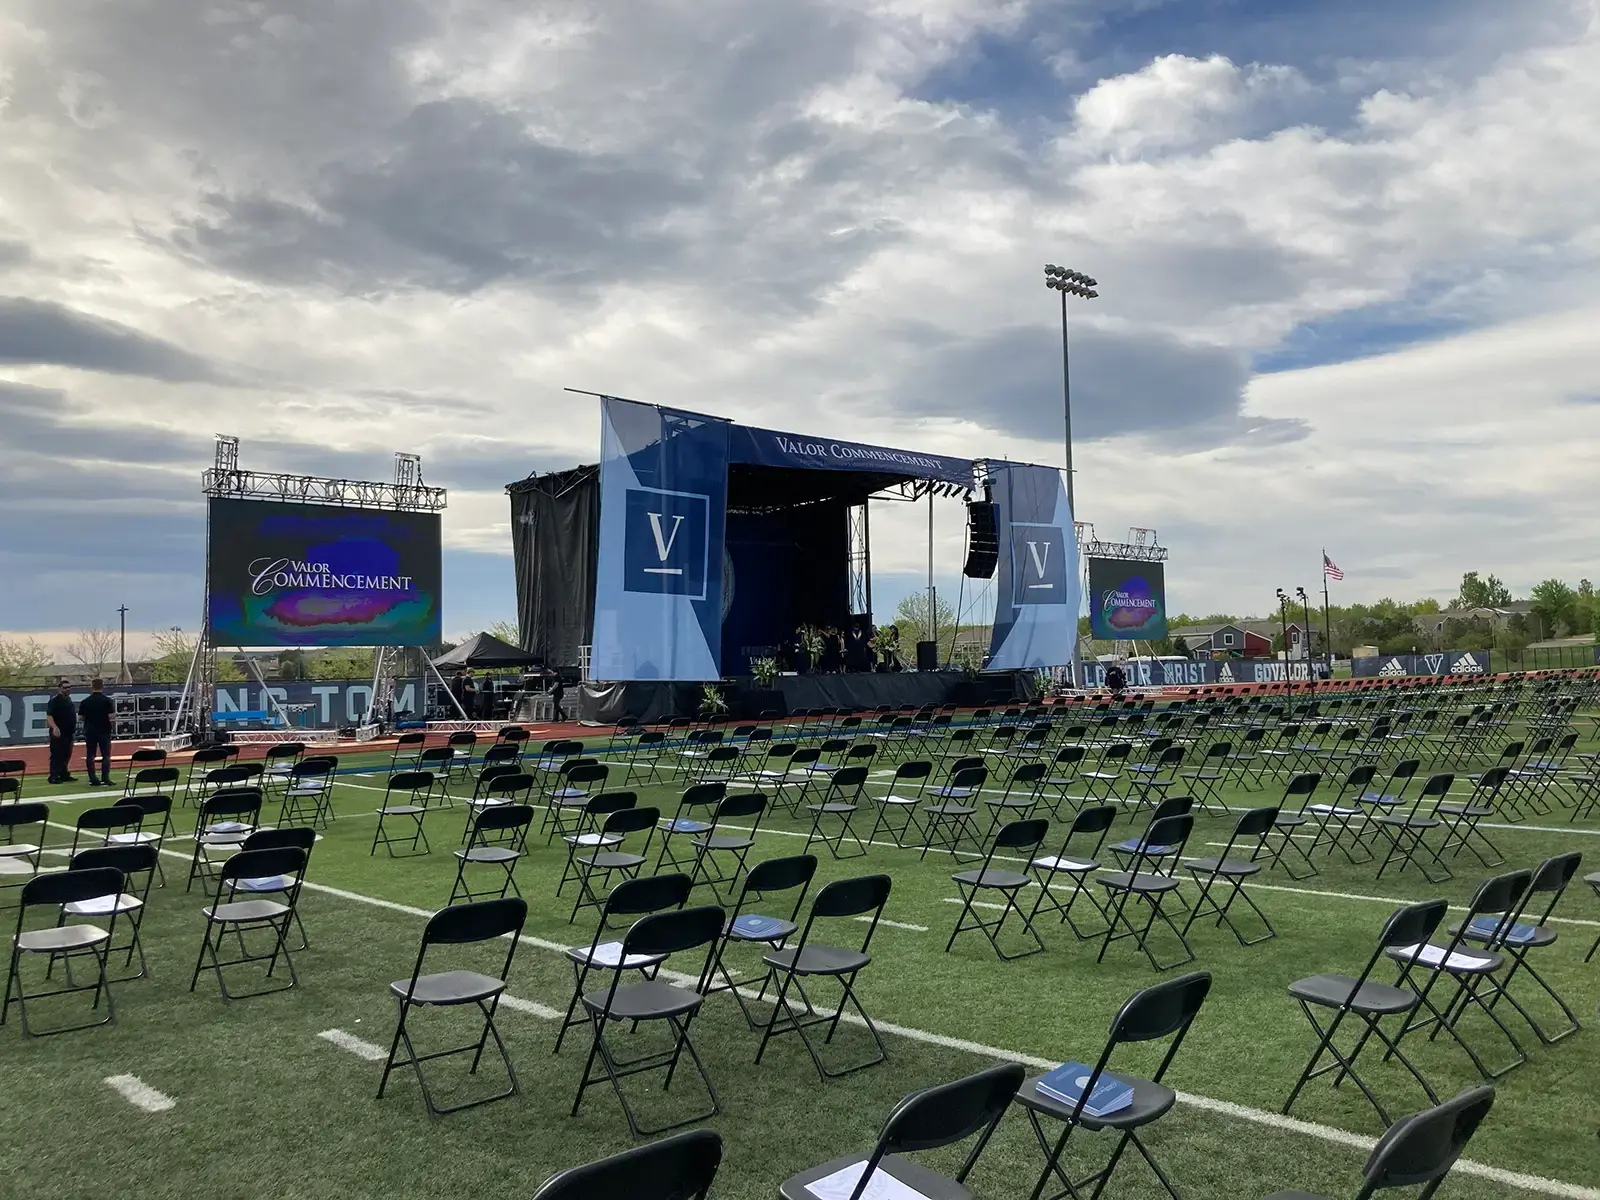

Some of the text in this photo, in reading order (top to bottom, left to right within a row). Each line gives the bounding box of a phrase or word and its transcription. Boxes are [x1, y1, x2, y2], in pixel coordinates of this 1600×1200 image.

[775, 436, 943, 470] VALOR COMMENCEMENT
[647, 512, 685, 561] V
[291, 560, 330, 573] VALOR
[1026, 541, 1051, 579] V
[247, 557, 412, 595] COMMENCEMENT
[1102, 589, 1156, 611] COMMENCEMENT
[1378, 669, 1407, 677] adidas
[1424, 653, 1444, 675] V
[1450, 664, 1483, 674] adidas
